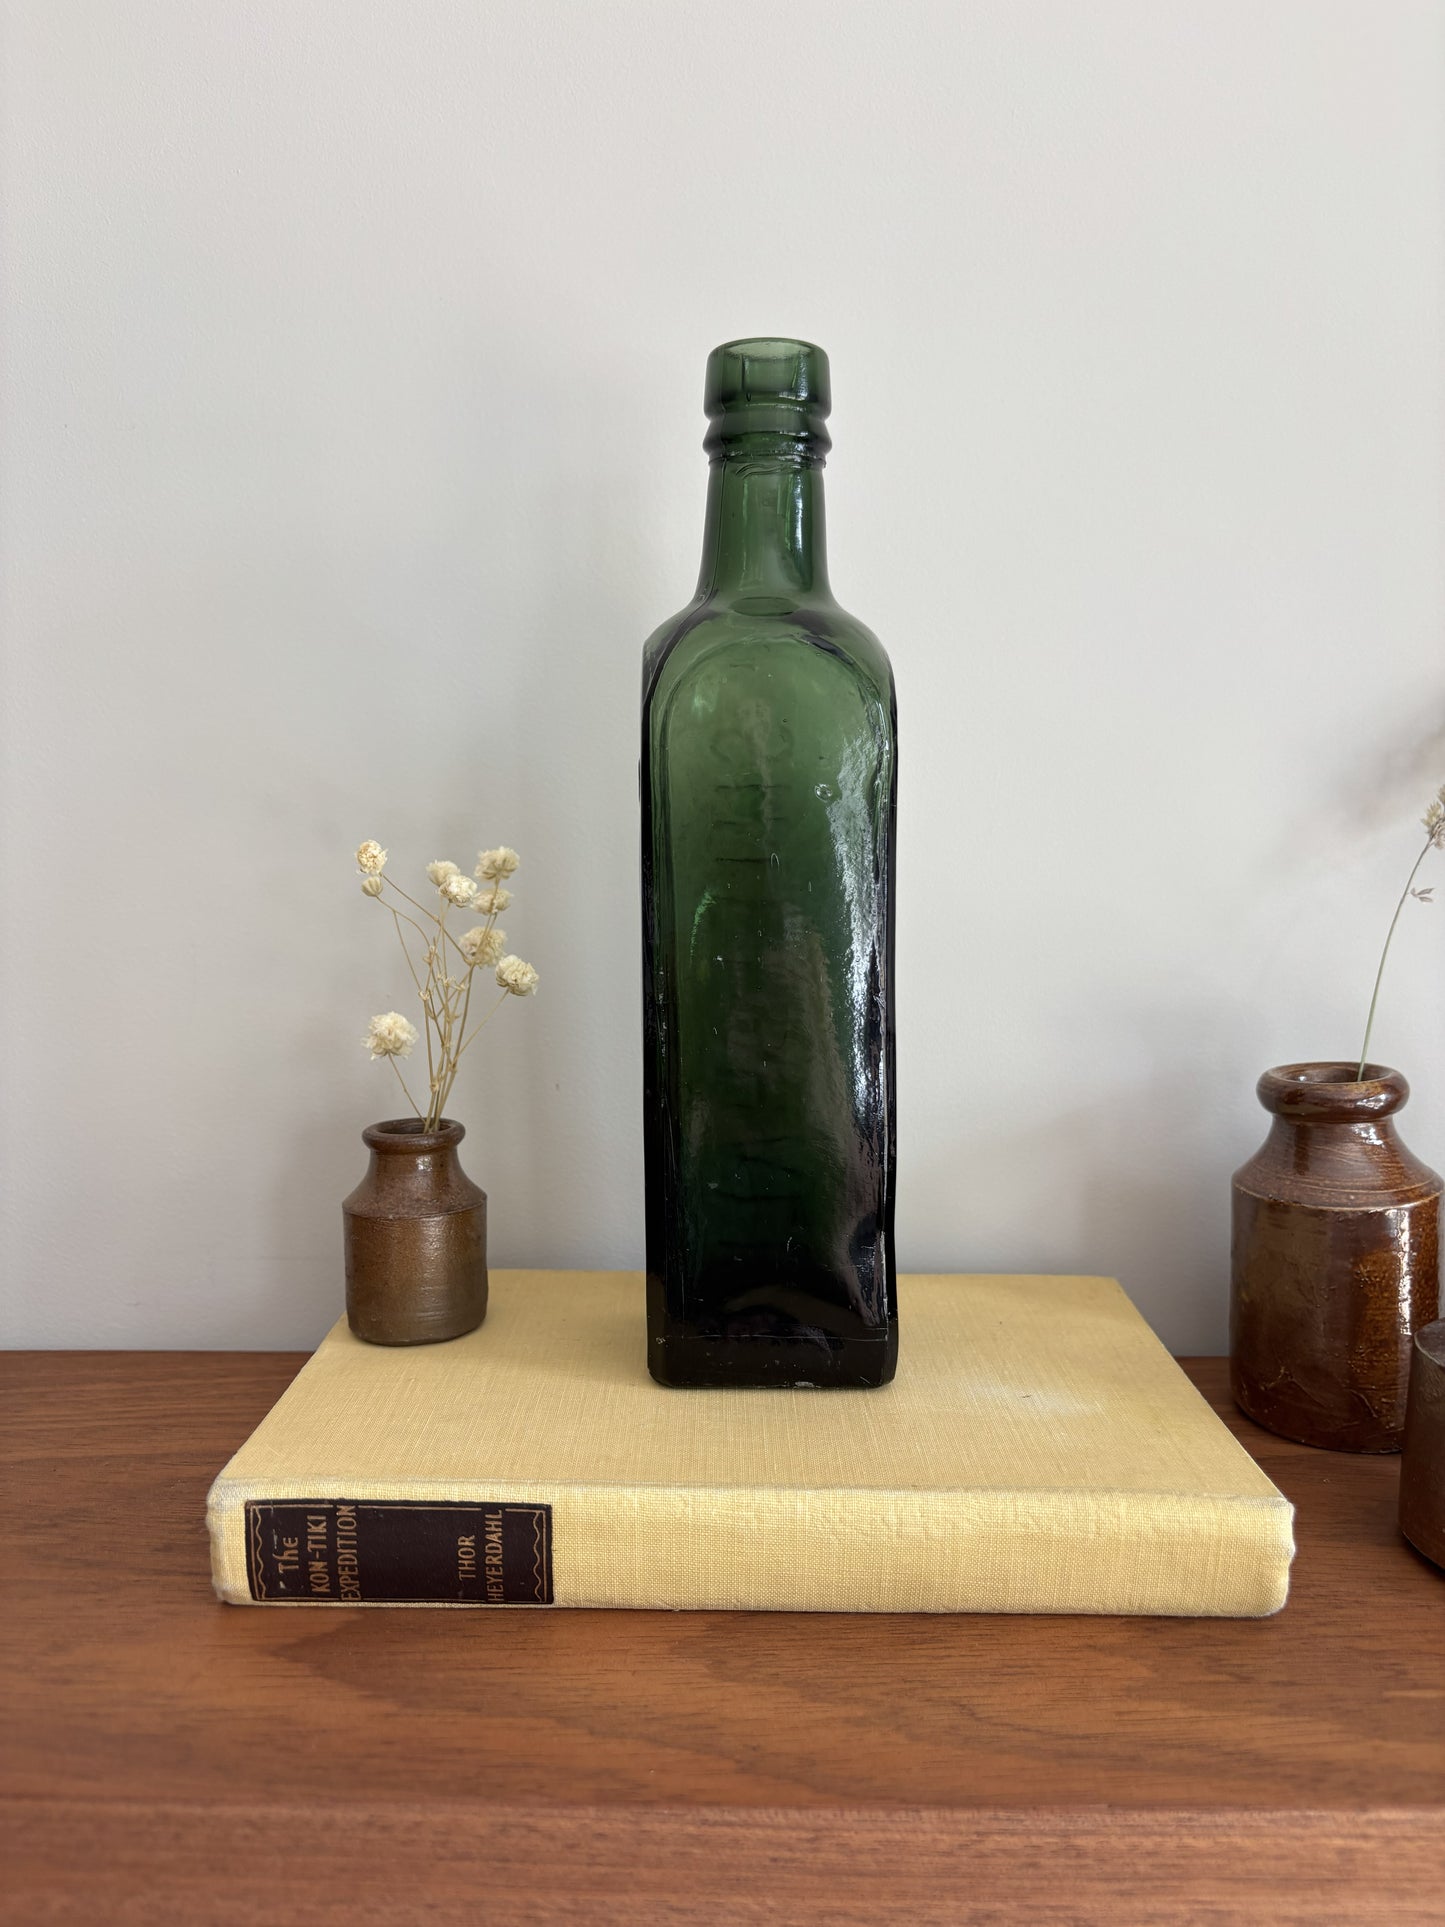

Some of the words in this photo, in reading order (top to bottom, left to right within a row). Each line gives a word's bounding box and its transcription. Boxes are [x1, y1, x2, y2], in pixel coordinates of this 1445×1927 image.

[273, 1536, 299, 1575] The
[306, 1515, 331, 1593] KON-TIKI
[336, 1504, 362, 1601] EXPEDITION
[458, 1534, 476, 1582] THOR
[485, 1509, 505, 1602] HEYERDAHL
